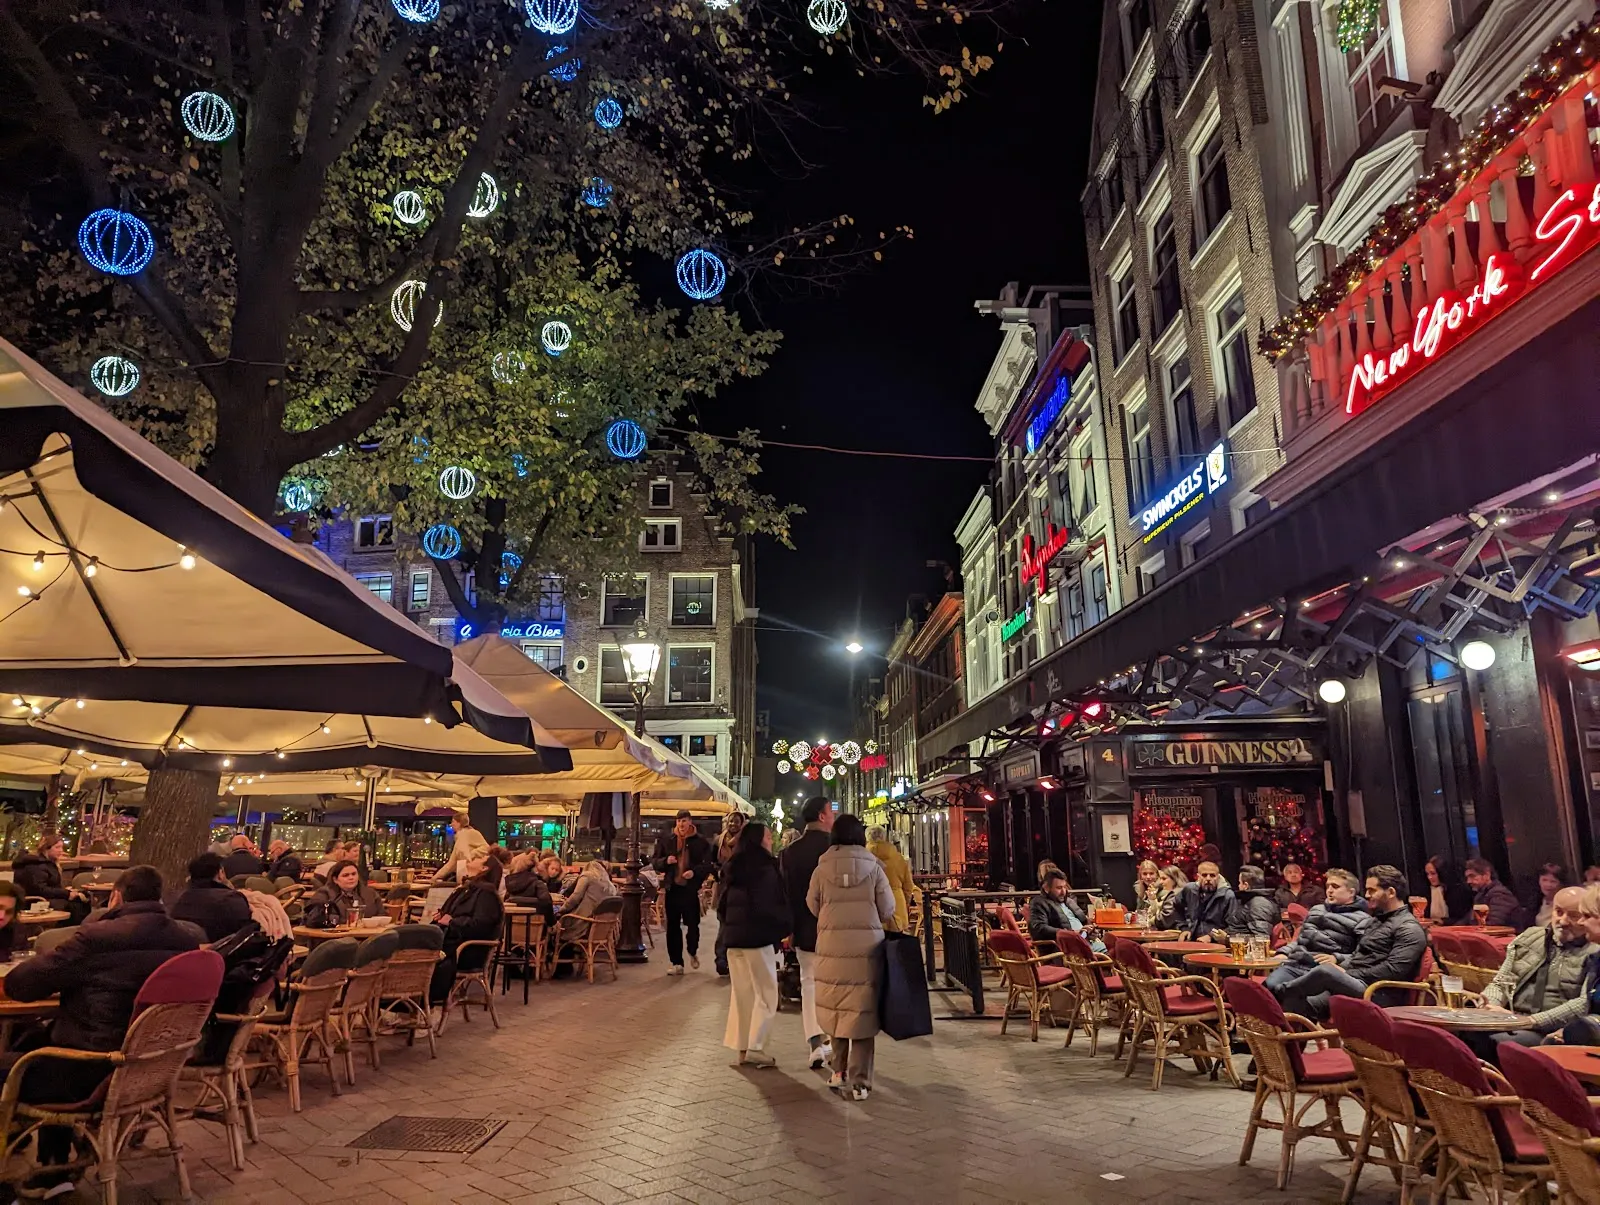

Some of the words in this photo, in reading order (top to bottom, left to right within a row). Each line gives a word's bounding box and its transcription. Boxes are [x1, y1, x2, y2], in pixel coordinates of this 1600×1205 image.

[1346, 343, 1410, 414] New
[1413, 255, 1509, 357] York
[1032, 376, 1069, 448] Bavaria
[1142, 462, 1204, 531] SWINCKELS'
[1143, 516, 1174, 544] SUPERIEUR
[1174, 492, 1205, 520] PILSENER
[1001, 610, 1027, 643] Heineken
[1101, 748, 1114, 762] 4
[1165, 741, 1293, 765] GUINNESS
[1145, 793, 1203, 807] Hoopman
[1178, 806, 1202, 819] Pub
